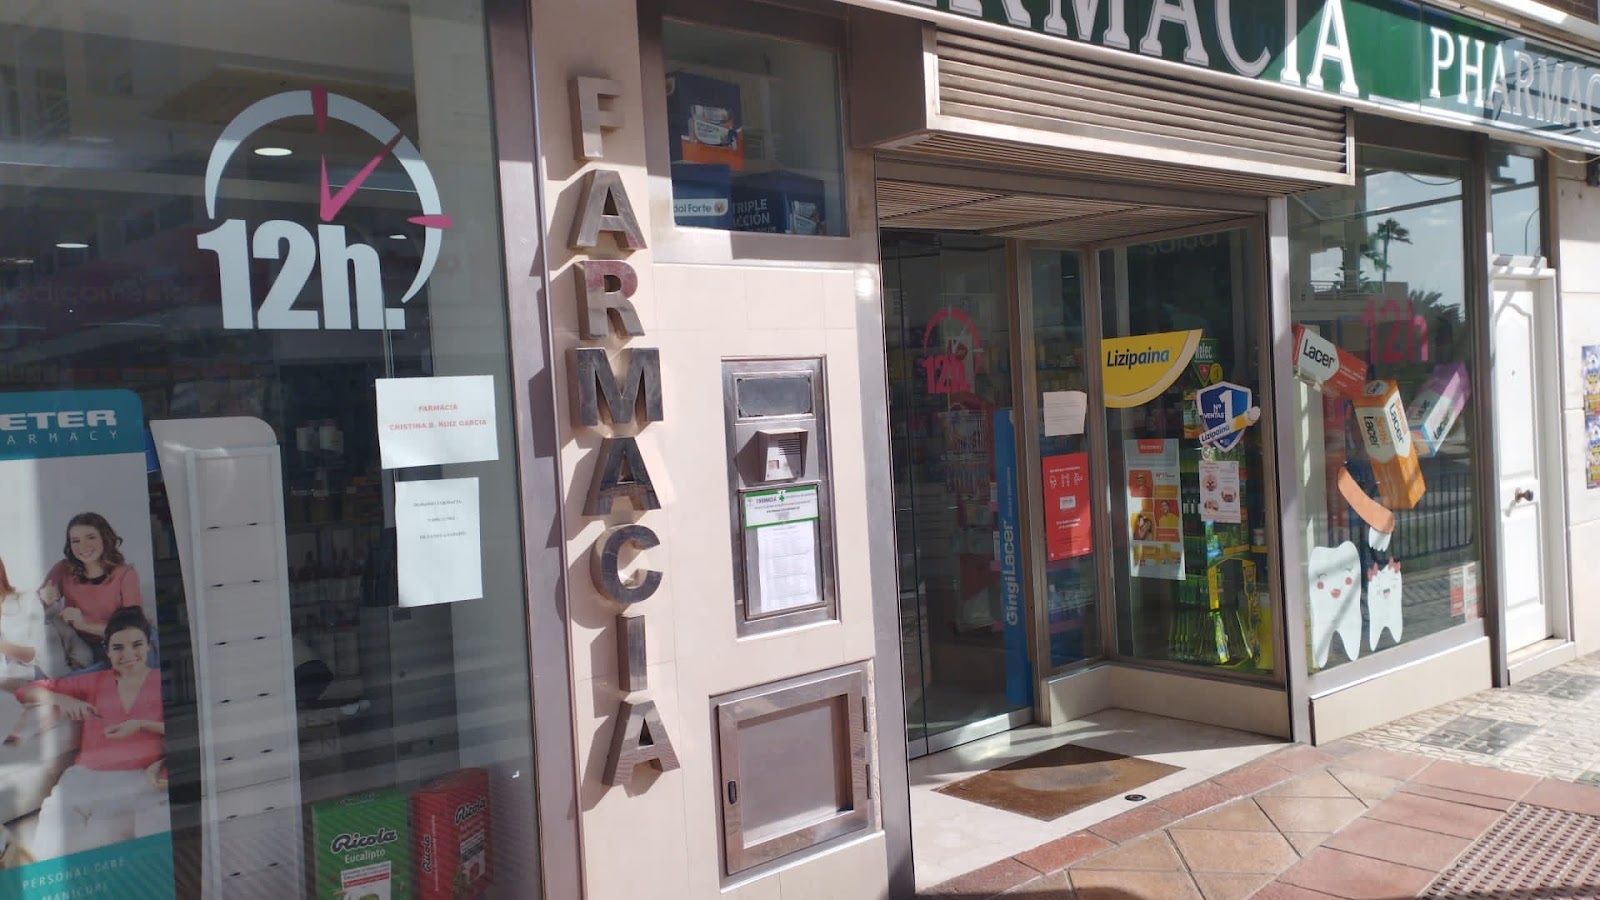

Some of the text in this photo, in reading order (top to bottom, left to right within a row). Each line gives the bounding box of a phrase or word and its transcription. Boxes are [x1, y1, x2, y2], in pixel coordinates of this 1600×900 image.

[688, 203, 712, 213] Forte
[732, 198, 768, 214] TRIPLE
[1106, 346, 1171, 370] Lizipaina
[1302, 338, 1336, 370] Lacer
[418, 403, 459, 413] FARMACIA
[389, 421, 428, 431] CRISTINA
[438, 420, 457, 428] RUIZ
[568, 74, 681, 788] FARMACIA
[1201, 424, 1231, 442] Lizipaina
[1363, 415, 1381, 449] Lacer
[1389, 402, 1405, 444] Lacer
[1002, 520, 1019, 626] GingiLacer
[330, 827, 399, 855] Ricola
[344, 848, 386, 864] Eucalipto
[22, 866, 89, 890] PERSONAL
